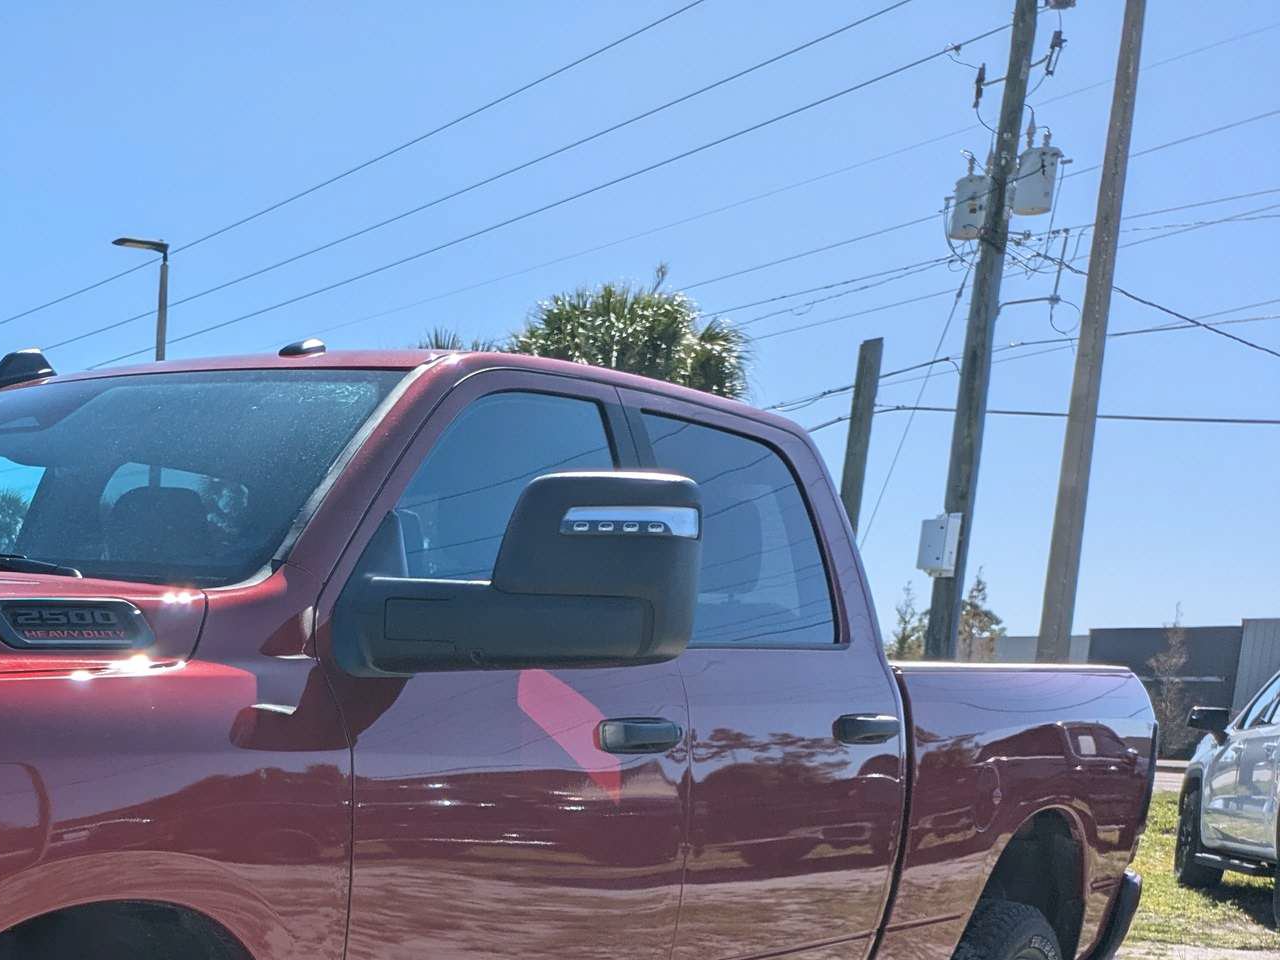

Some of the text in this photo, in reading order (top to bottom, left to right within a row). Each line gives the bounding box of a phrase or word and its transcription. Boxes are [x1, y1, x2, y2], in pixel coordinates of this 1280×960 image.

[17, 608, 119, 625] 2500
[24, 630, 126, 639] HEAVY DUTY
